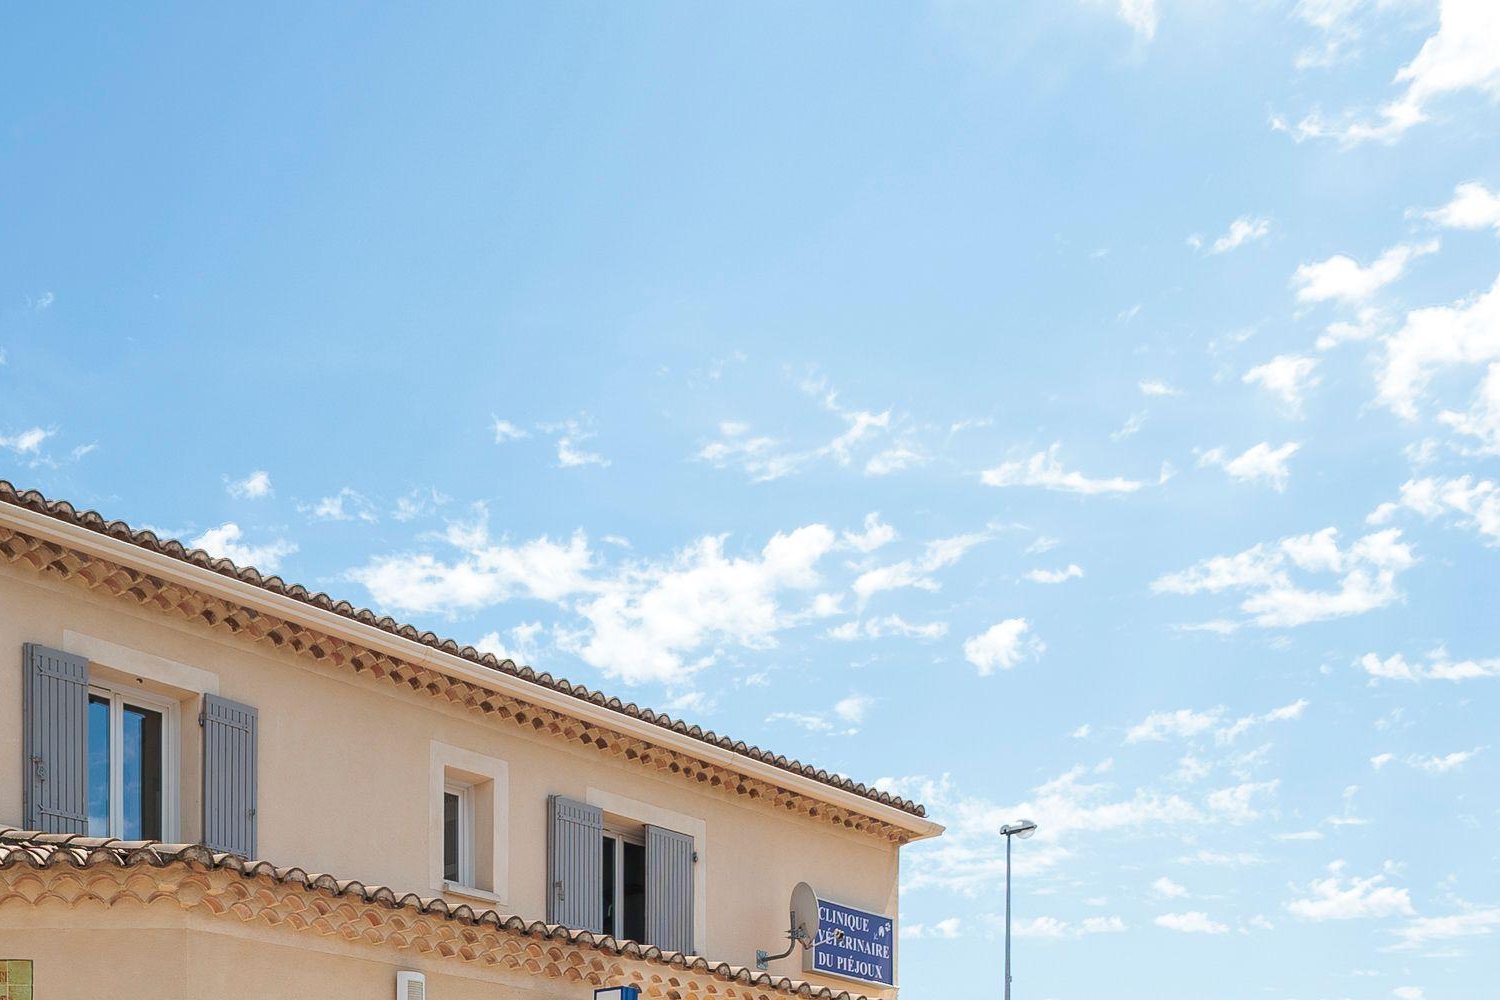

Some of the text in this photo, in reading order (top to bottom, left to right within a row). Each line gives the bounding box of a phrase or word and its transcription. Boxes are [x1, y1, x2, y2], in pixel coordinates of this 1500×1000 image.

[819, 907, 869, 932] CLINIQUE
[819, 952, 883, 979] DU PIÉJOUX
